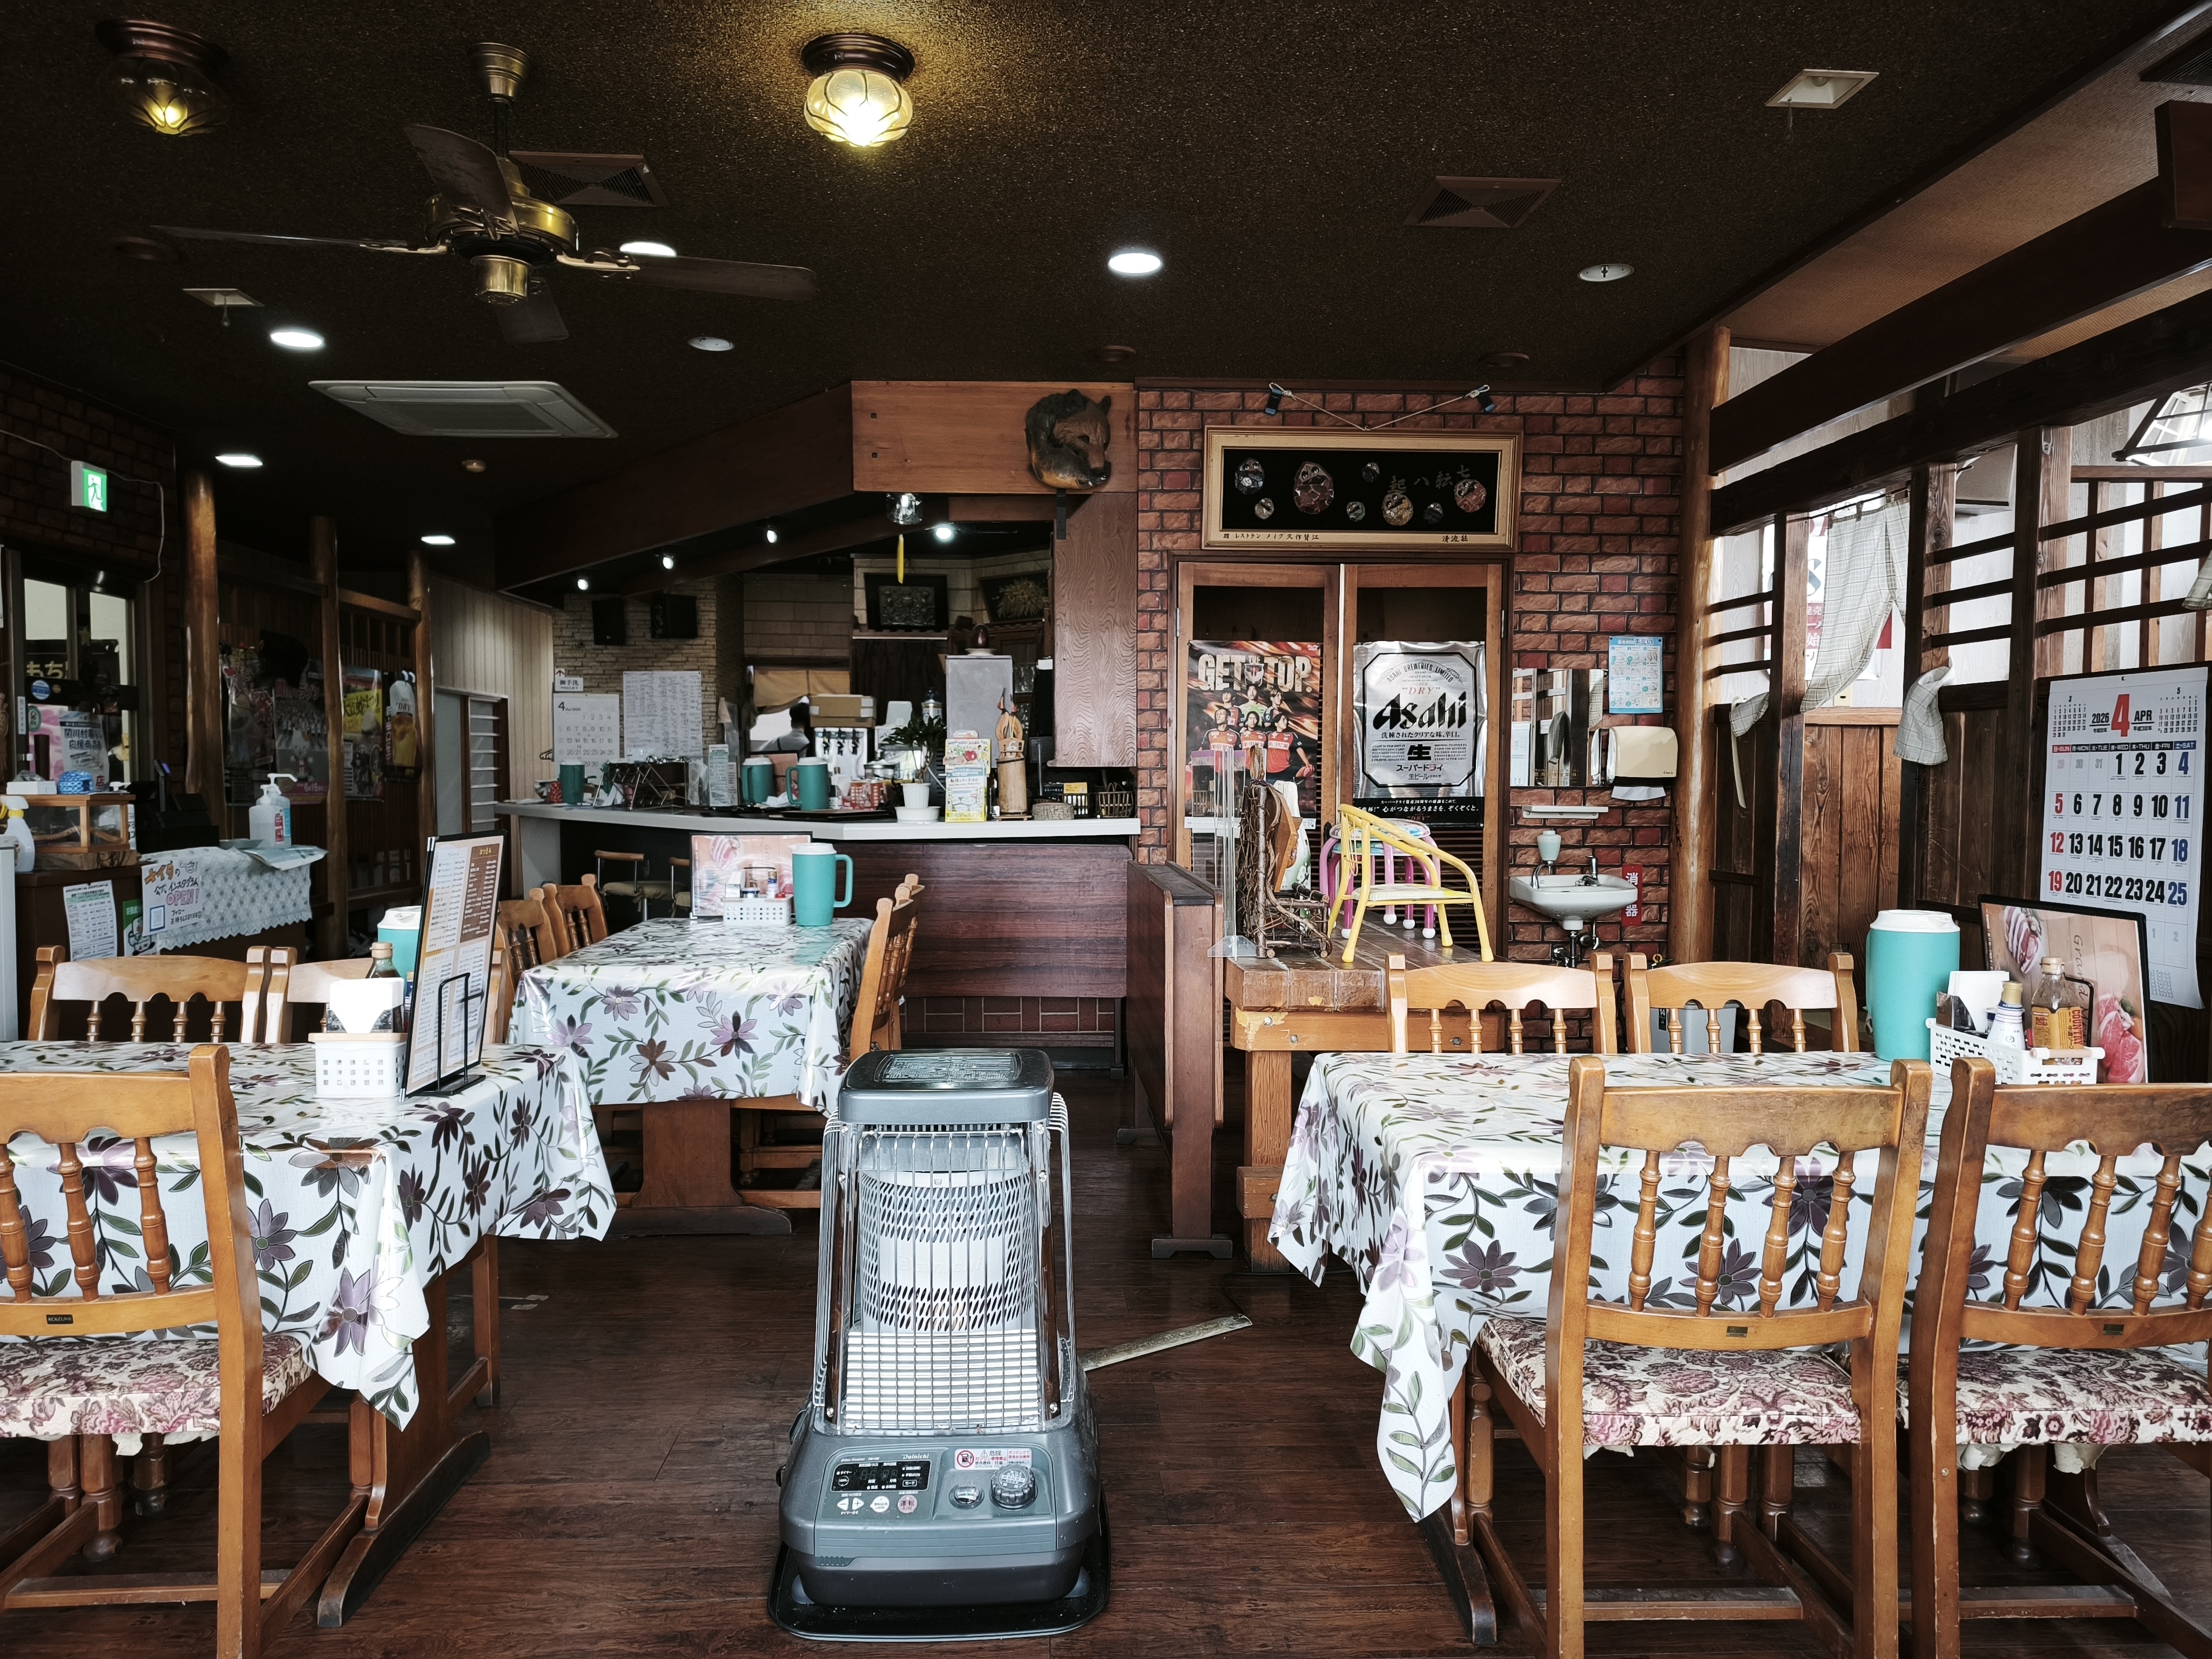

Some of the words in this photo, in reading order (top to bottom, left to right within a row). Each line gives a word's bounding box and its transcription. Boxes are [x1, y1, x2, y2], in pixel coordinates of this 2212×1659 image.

[1198, 653, 1246, 691] GET
[1264, 655, 1312, 693] TOP.
[1386, 668, 1402, 684] ASAHI
[1404, 662, 1433, 672] BREWERIES
[1435, 666, 1454, 683] LIMITED
[558, 702, 565, 711] 4
[1373, 691, 1466, 730] Asahi
[2092, 712, 2109, 724] 2026
[2111, 693, 2130, 737] 4
[2134, 710, 2152, 721] APR
[1407, 744, 1432, 761] 生
[2095, 759, 2103, 769] 31
[2116, 753, 2123, 775] 1
[2134, 752, 2145, 775] 2
[2156, 752, 2167, 775] 3
[2178, 751, 2189, 775] 4
[1396, 764, 1443, 772] スーパードライ
[2054, 793, 2063, 814] 5
[2073, 793, 2082, 814] 6
[2093, 794, 2102, 815] 7
[2113, 794, 2122, 816] 8
[2133, 794, 2143, 817] 9
[2152, 794, 2168, 818] 10
[2174, 795, 2189, 819] 11
[2050, 832, 2064, 853] 12
[2068, 833, 2083, 854] 13
[2087, 834, 2103, 855] 14
[2107, 835, 2123, 857] 15
[2128, 836, 2144, 859] 16
[2149, 837, 2166, 860] 17
[2171, 838, 2188, 862] 18
[168, 876, 199, 892] インスタグラム
[1626, 872, 1638, 917] 消器
[2048, 871, 2062, 892] 19
[2065, 872, 2082, 894] 20
[2086, 874, 2101, 896] 21
[2104, 875, 2122, 899] 22
[2125, 877, 2143, 901] 23
[2145, 879, 2165, 903] 24
[2167, 881, 2187, 906] 25
[166, 888, 200, 906] OPEN!
[2152, 928, 2155, 939] 1
[2173, 931, 2179, 942] 2
[2073, 934, 2088, 1001] Grand
[2072, 1010, 2083, 1046] COUNTRY
